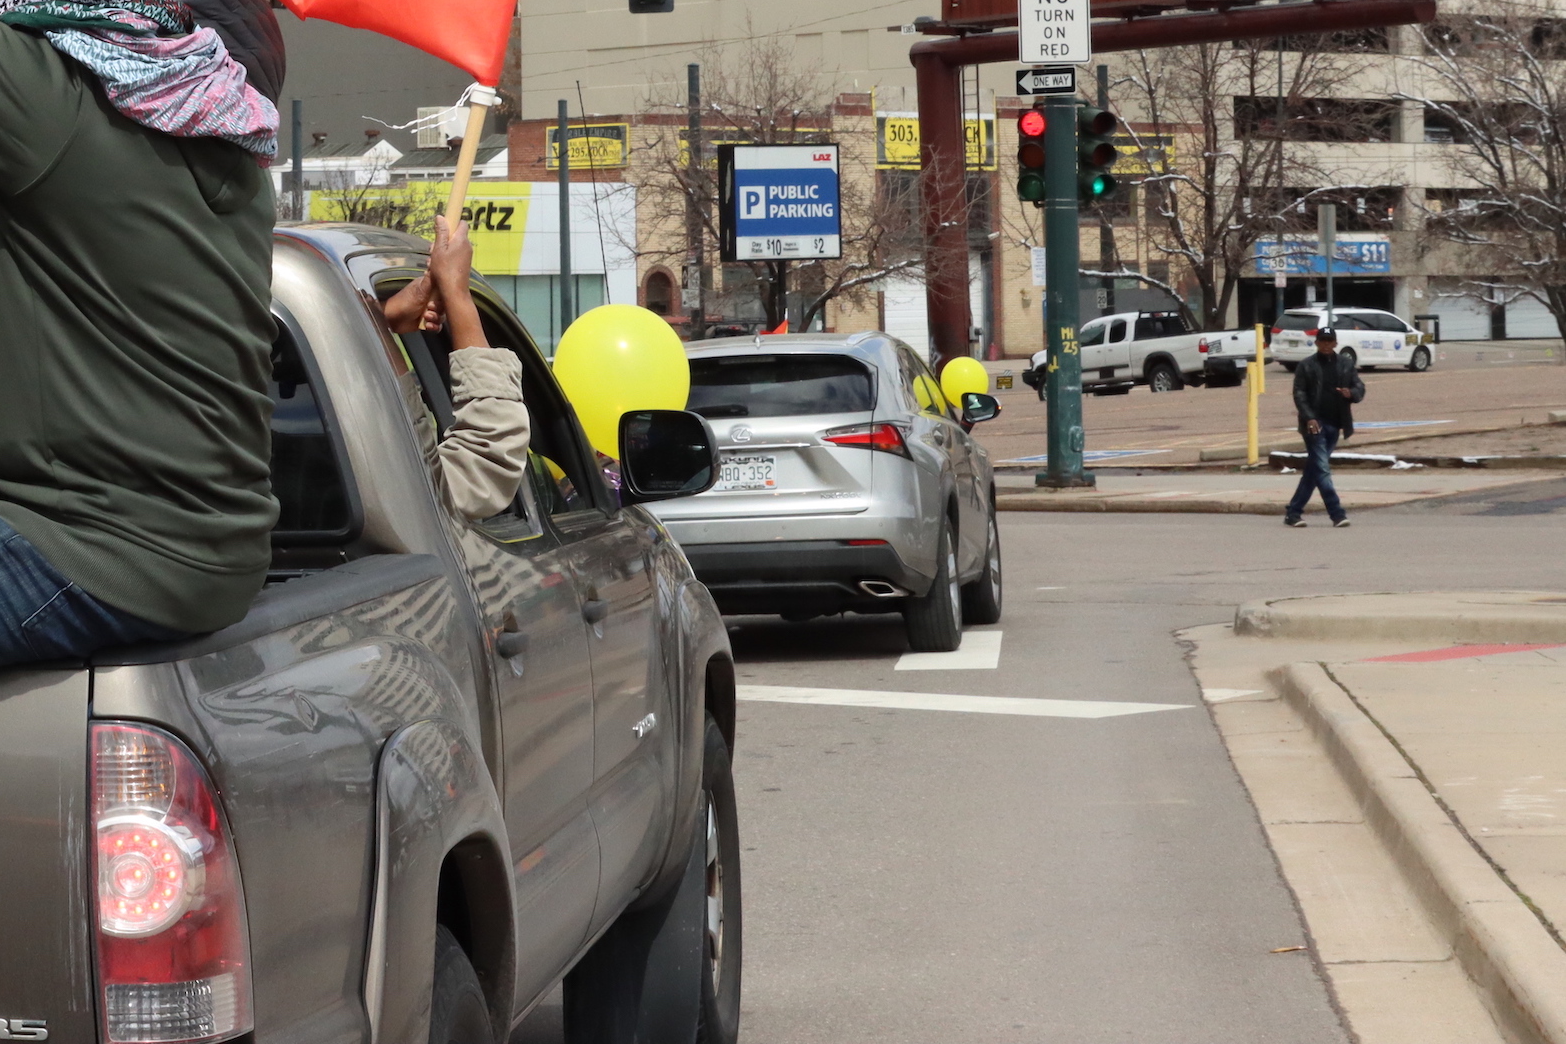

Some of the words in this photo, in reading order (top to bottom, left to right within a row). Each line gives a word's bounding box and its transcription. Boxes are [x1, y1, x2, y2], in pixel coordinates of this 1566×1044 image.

[1035, 9, 1074, 22] TURN
[1044, 26, 1066, 39] ON
[1040, 44, 1070, 56] RED
[1033, 76, 1050, 87] ONE
[1053, 75, 1069, 86] WAY
[769, 185, 819, 199] PUBLIC
[770, 203, 833, 218] PARKING
[767, 239, 781, 256] $10
[814, 238, 824, 254] $2
[1272, 258, 1284, 268] 30
[1098, 296, 1106, 304] 20
[1062, 341, 1078, 355] 25
